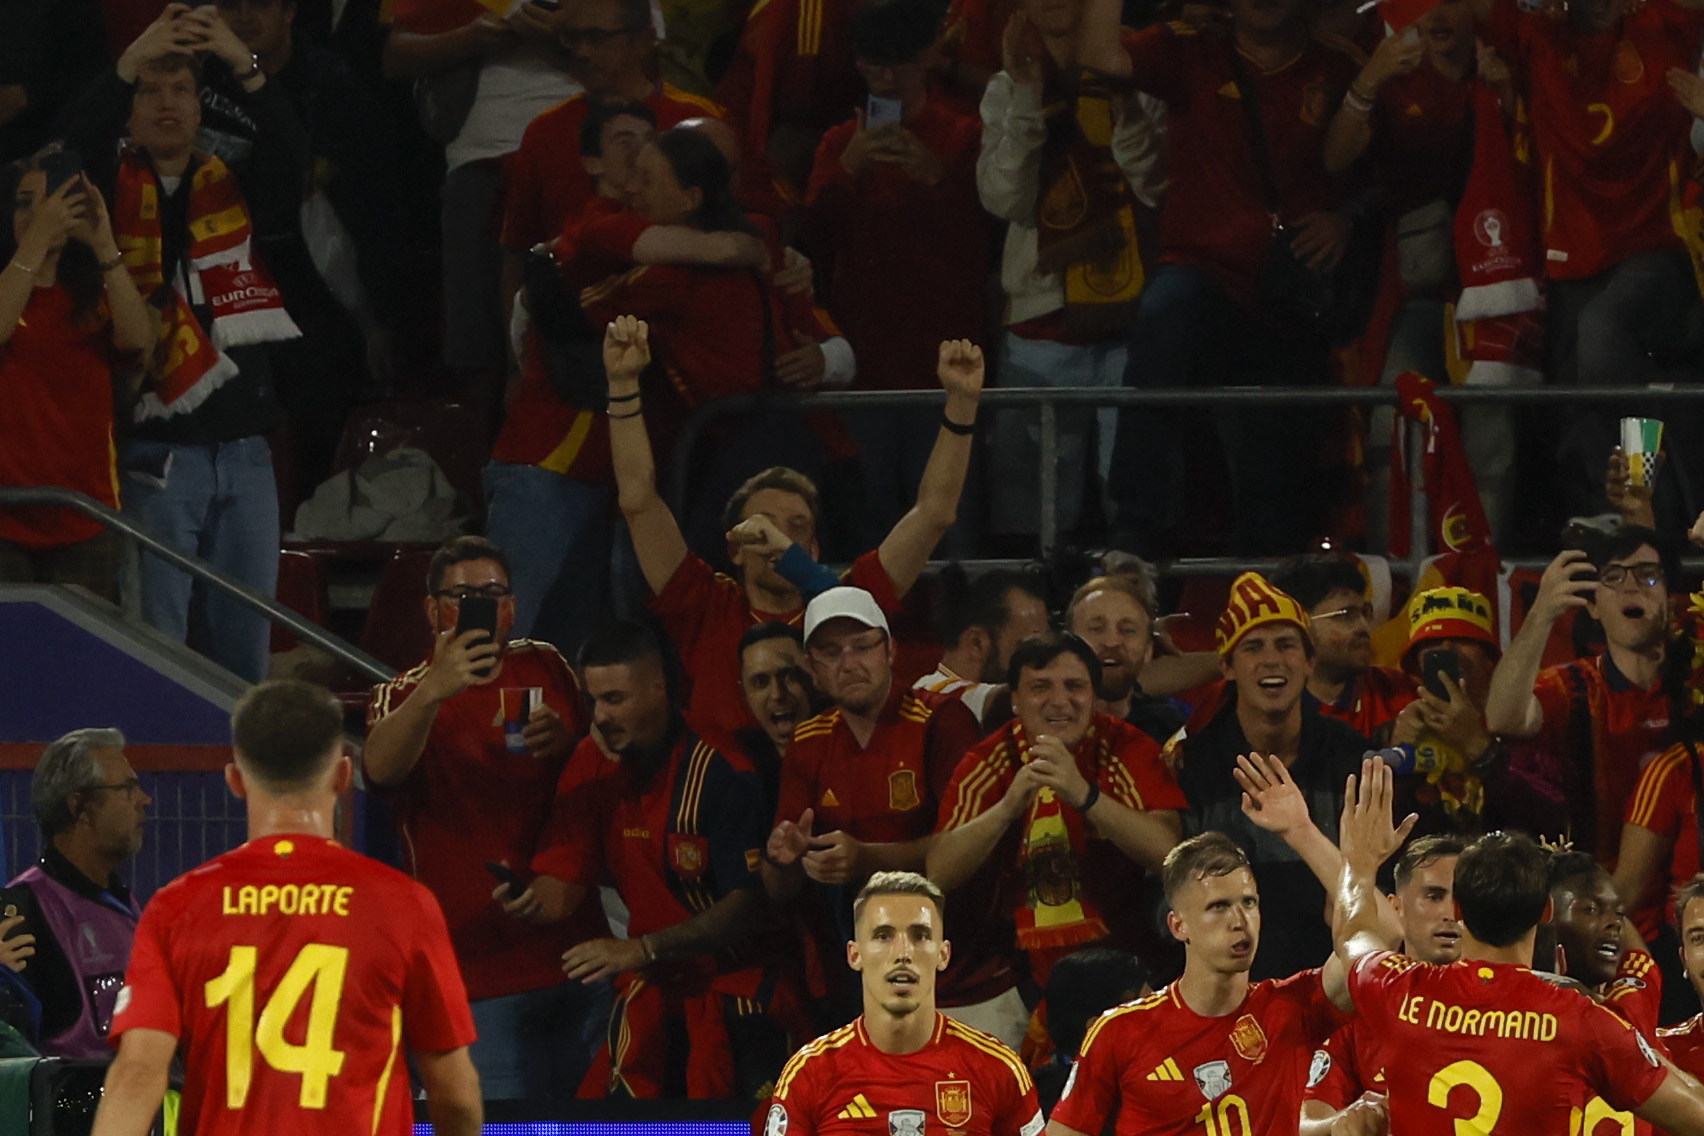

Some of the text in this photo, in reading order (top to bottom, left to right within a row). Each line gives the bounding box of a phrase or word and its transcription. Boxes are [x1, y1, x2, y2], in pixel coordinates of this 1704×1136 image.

[222, 883, 354, 917] LAPORTE
[204, 943, 349, 1110] 14
[1398, 993, 1558, 1041] LE NORMAND
